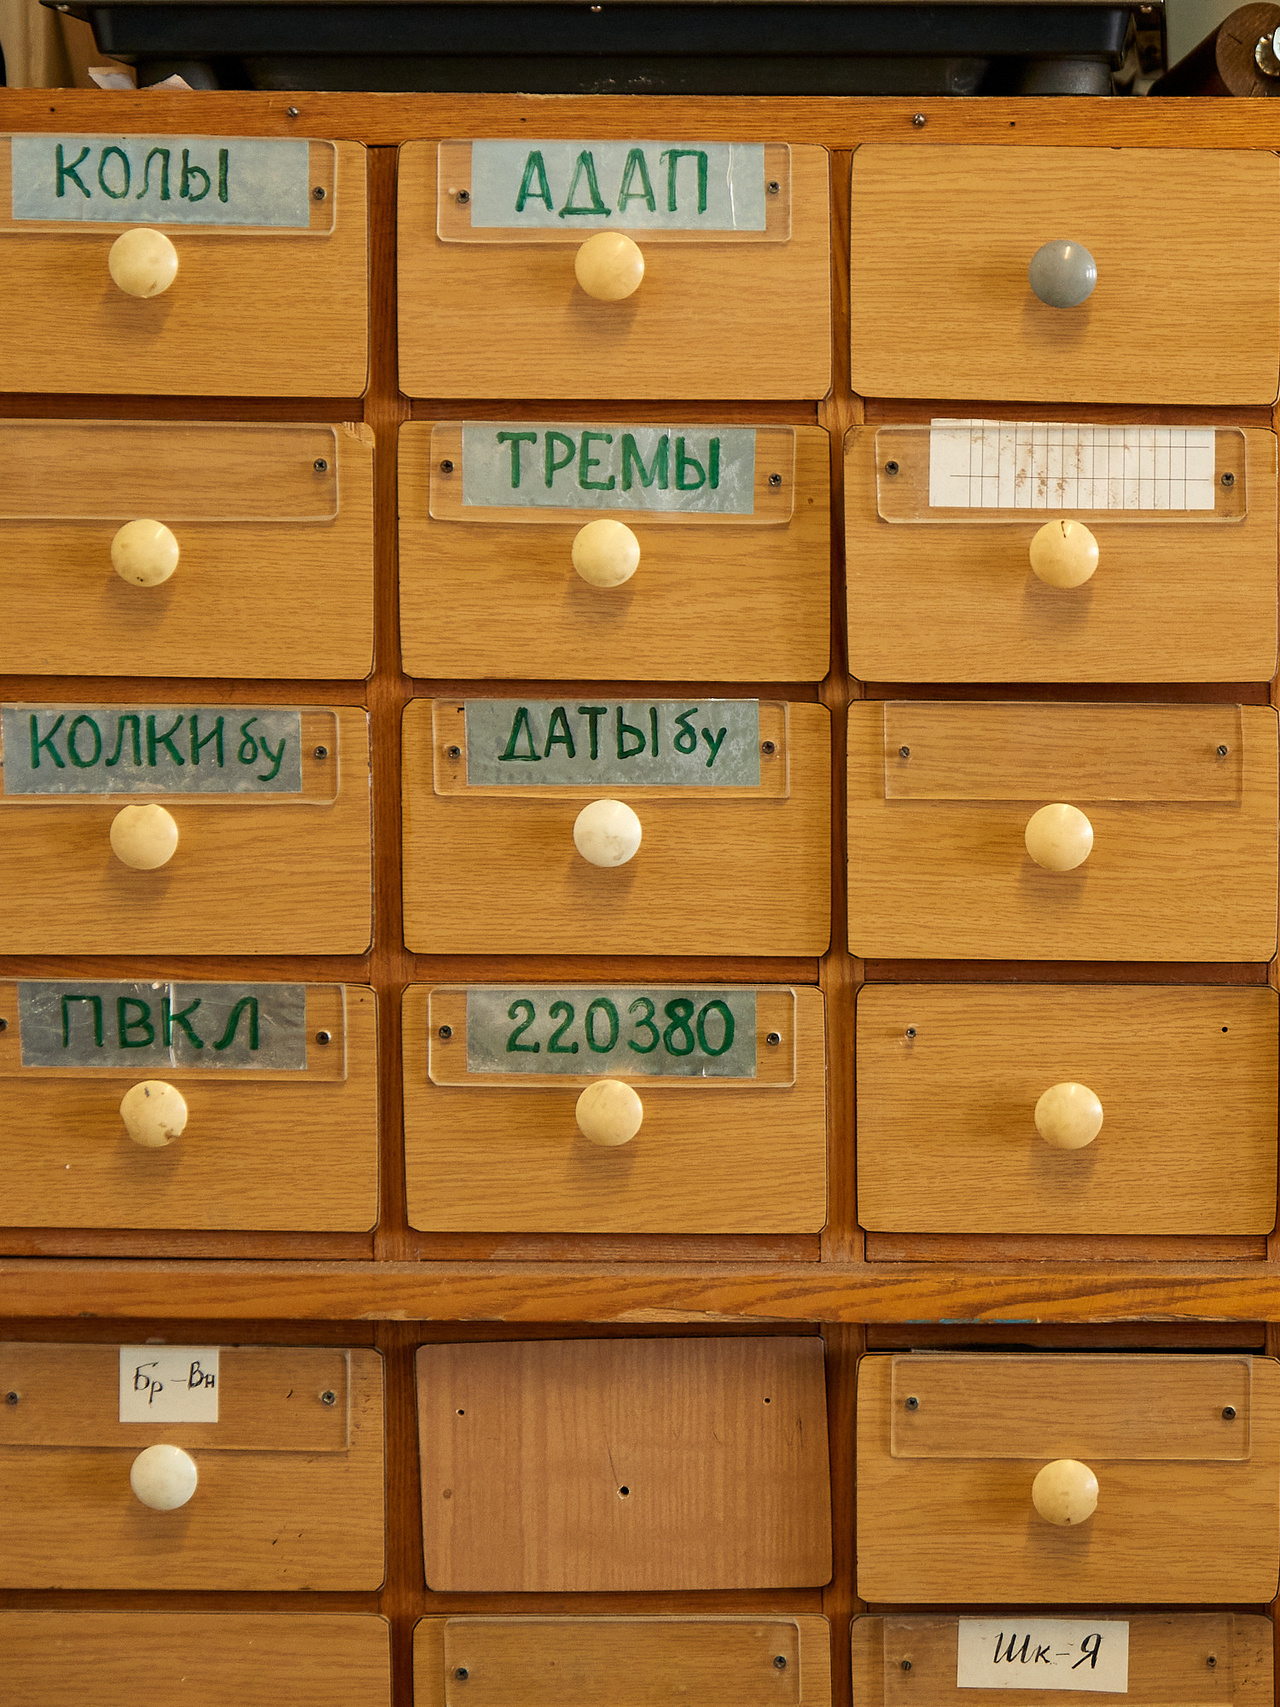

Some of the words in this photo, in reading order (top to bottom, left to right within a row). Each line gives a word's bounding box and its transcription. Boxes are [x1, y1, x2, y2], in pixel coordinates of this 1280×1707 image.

[55, 144, 229, 203] КОЛЫ
[515, 148, 708, 218] АДАП
[496, 431, 721, 491] ТРЕМЫ
[30, 714, 225, 768] КОЛКИ
[497, 706, 659, 761] ДАТЫ
[61, 994, 259, 1051] ПВКЛ
